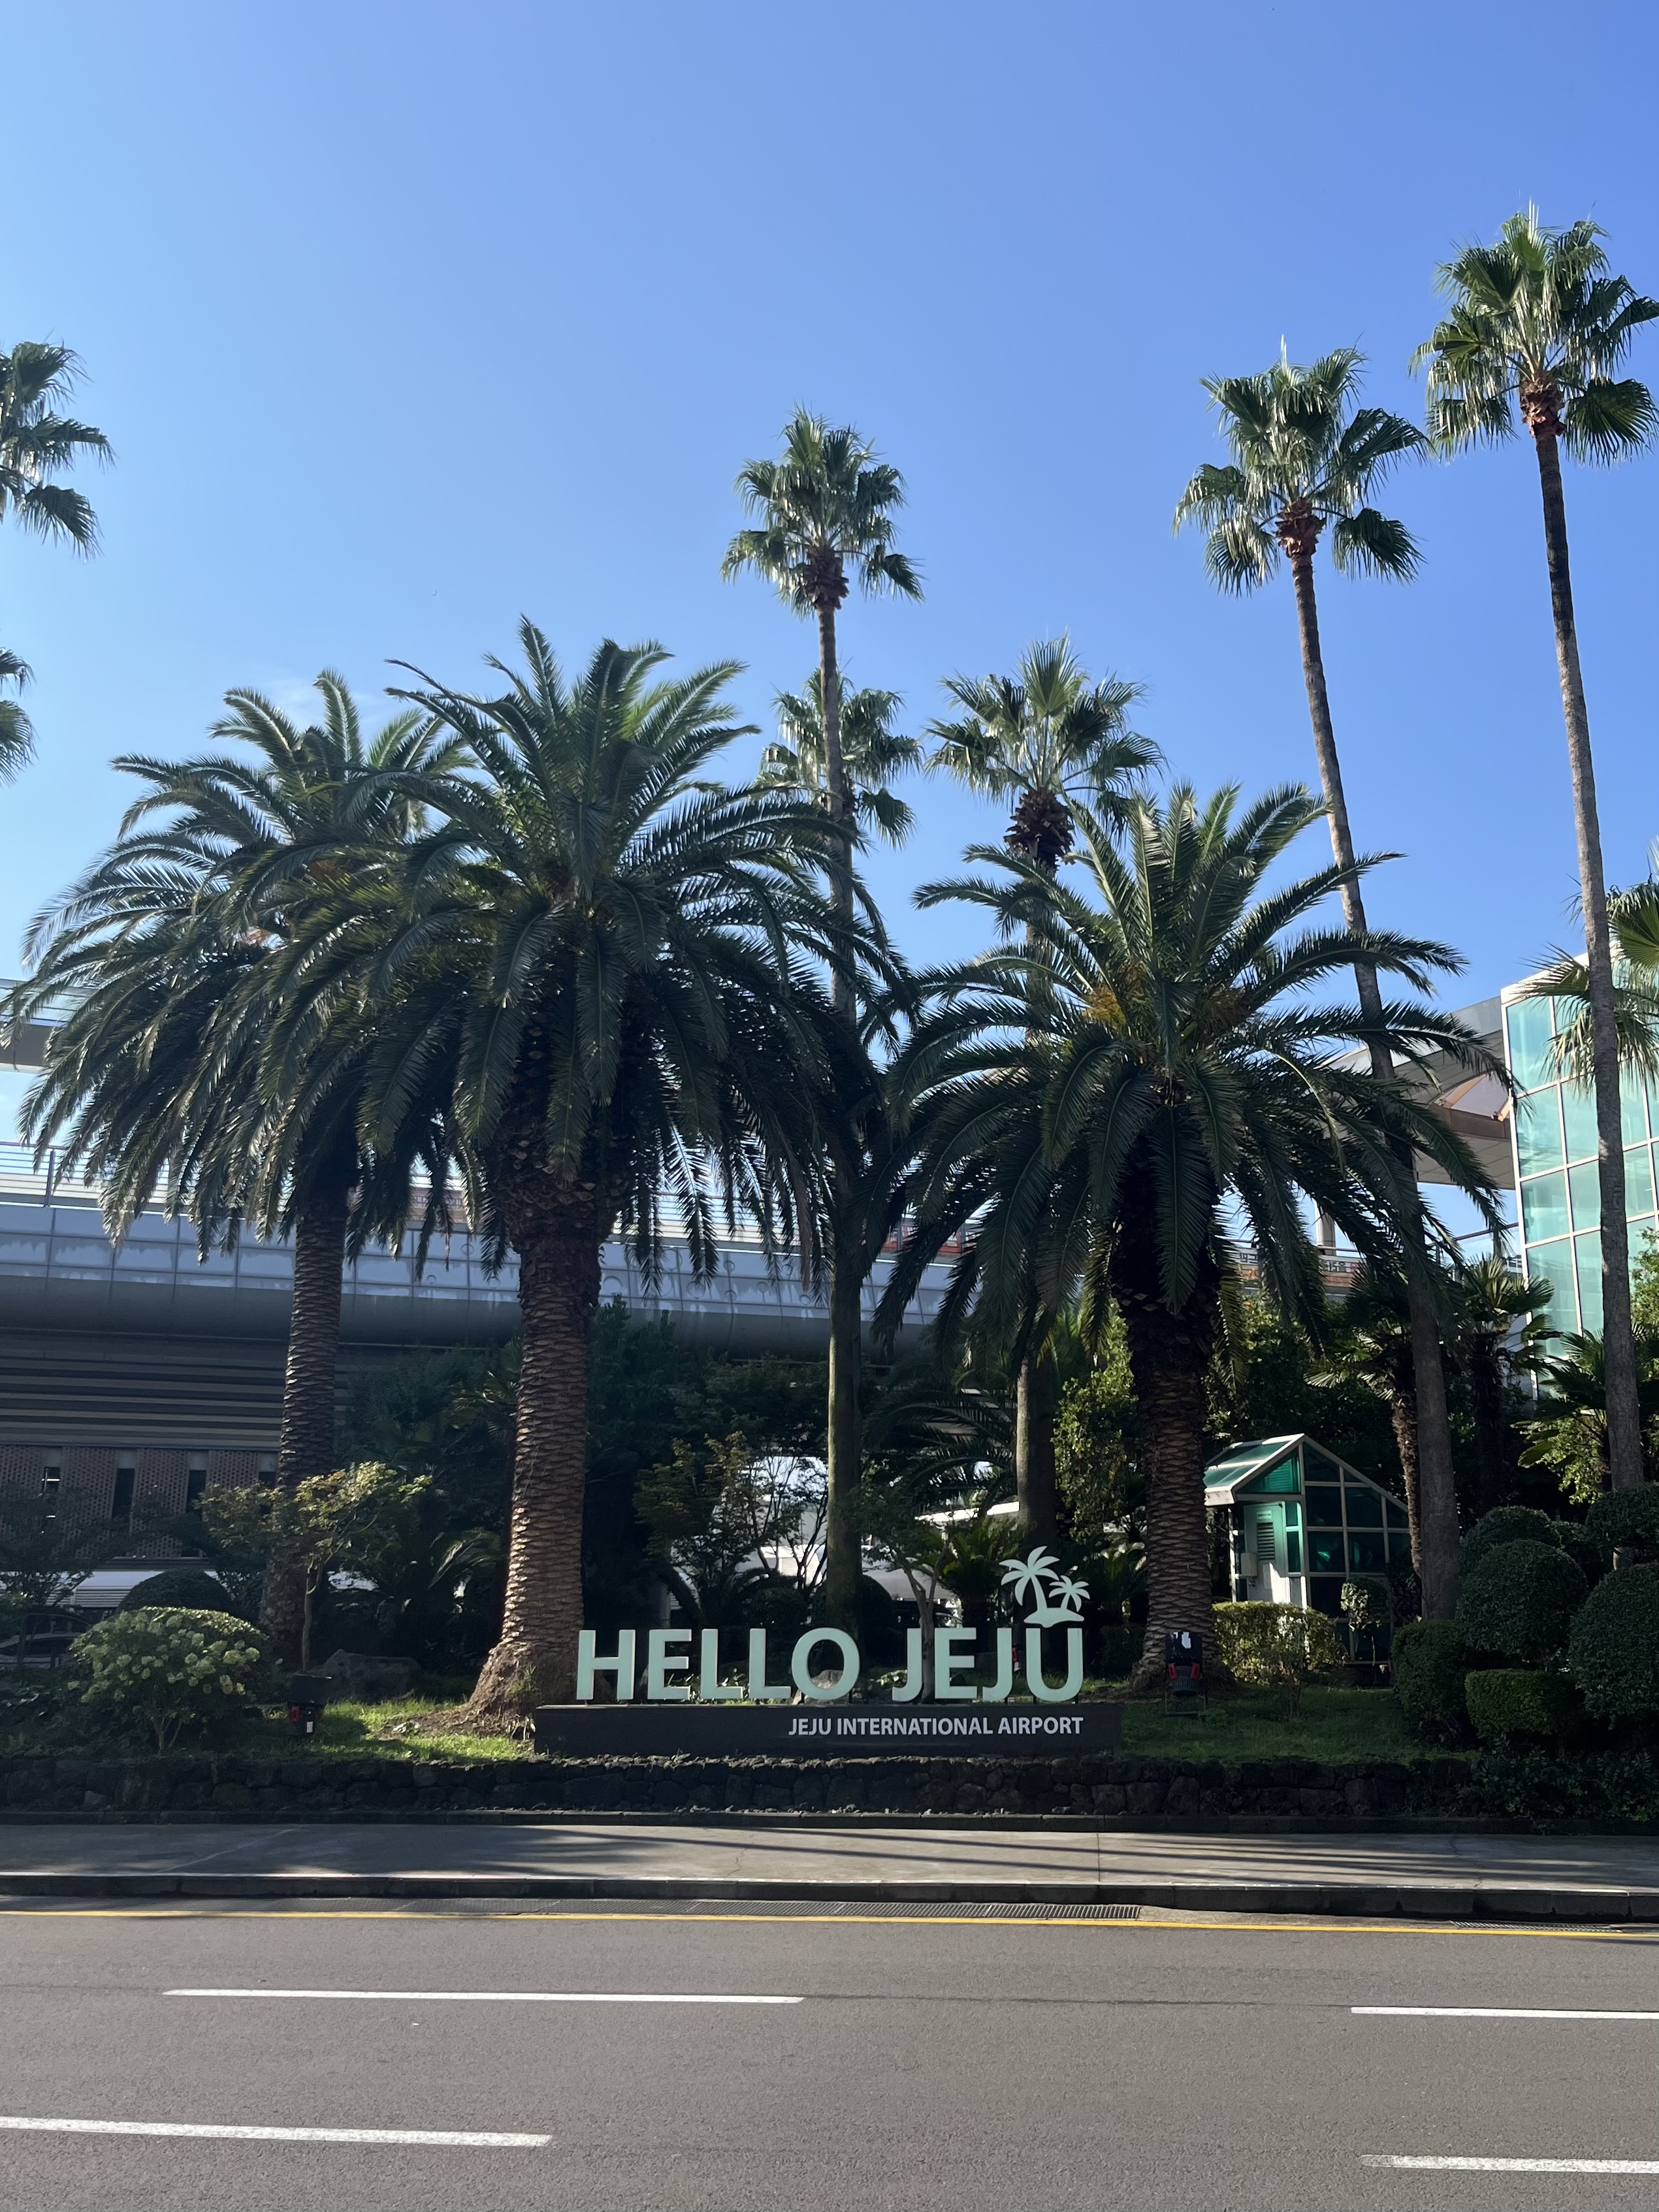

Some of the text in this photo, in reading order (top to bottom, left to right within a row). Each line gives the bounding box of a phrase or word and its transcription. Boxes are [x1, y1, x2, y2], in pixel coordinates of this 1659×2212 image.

[576, 1627, 1084, 1702] HELLO JEJU
[788, 1716, 1084, 1735] JEJU INTERNATIONAL AIRPORT
